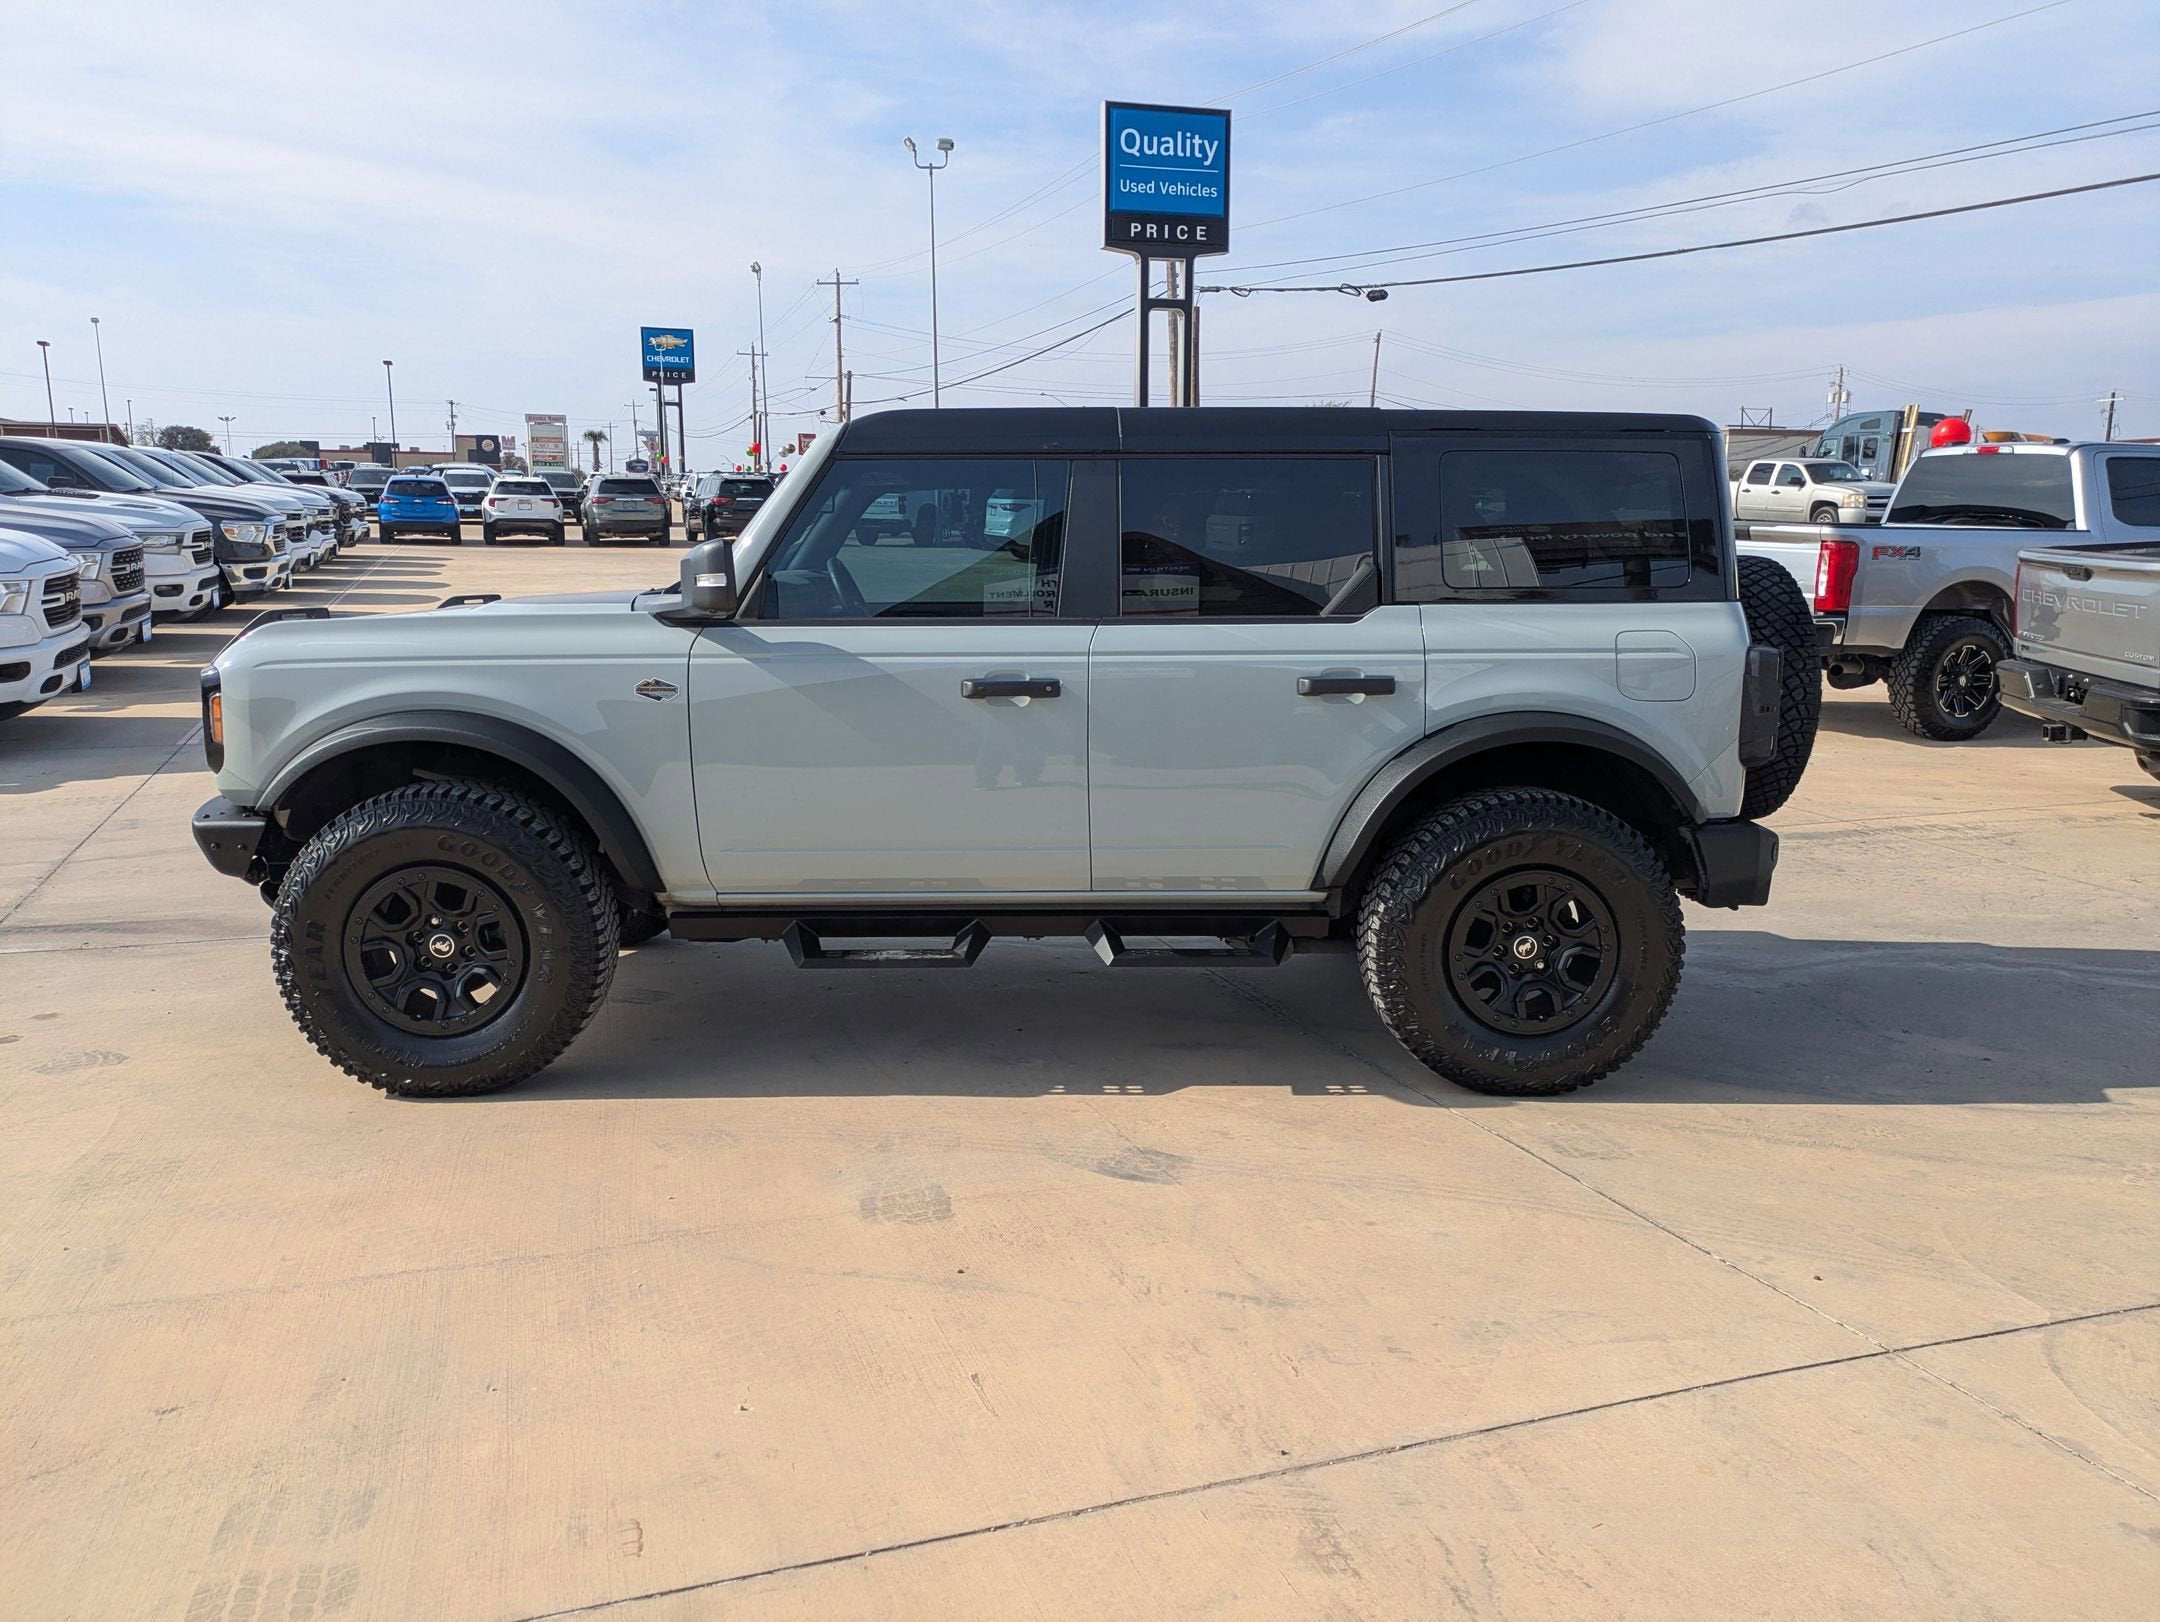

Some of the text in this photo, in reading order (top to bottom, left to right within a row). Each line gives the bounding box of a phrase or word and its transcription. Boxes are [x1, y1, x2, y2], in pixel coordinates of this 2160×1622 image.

[1120, 128, 1219, 166] Quality
[1120, 179, 1218, 198] Used Vehicles
[1130, 223, 1207, 241] PRICE
[646, 355, 690, 364] CHEVROLET
[1872, 546, 1921, 560] FX4
[2022, 588, 2148, 619] CHEVROLET
